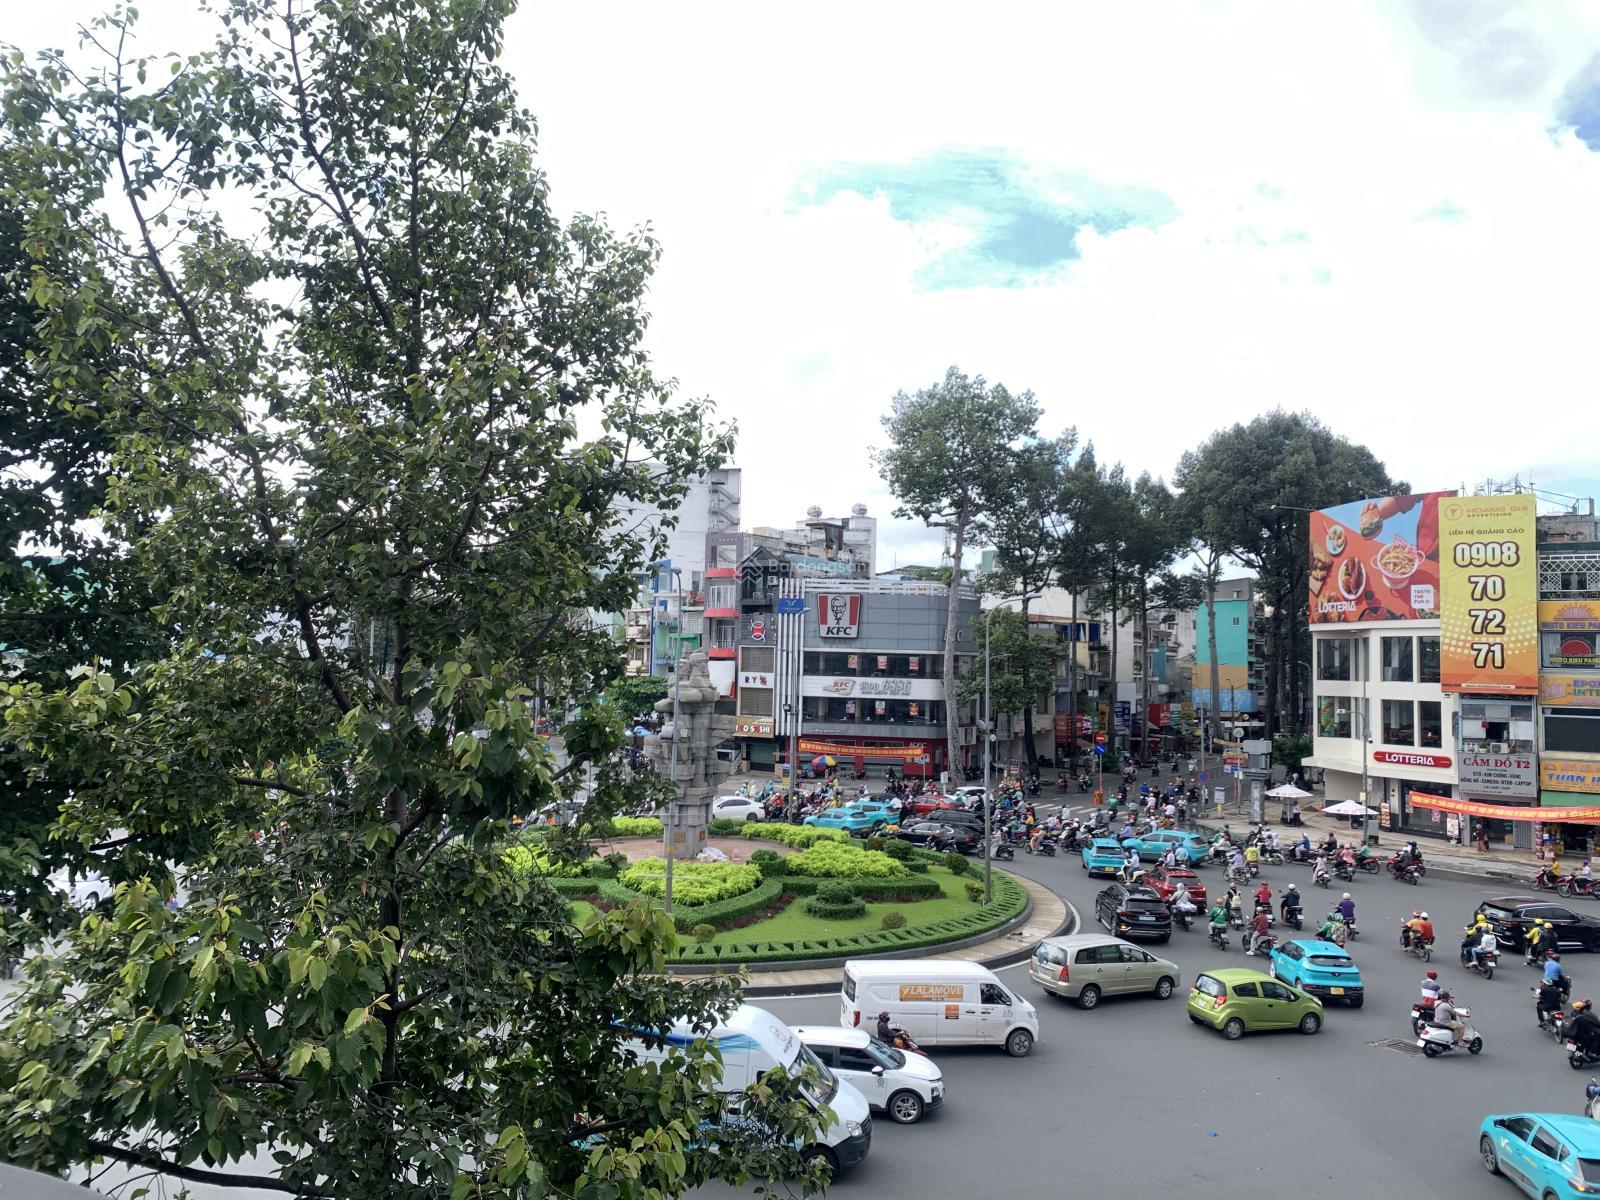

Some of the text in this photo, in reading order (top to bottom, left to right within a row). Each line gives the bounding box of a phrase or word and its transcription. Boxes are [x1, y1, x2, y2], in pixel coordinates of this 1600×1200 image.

[1454, 541, 1520, 568] 0908
[1469, 575, 1506, 602] 70
[1318, 601, 1357, 614] LOTTERIA
[1469, 608, 1506, 636] 72
[826, 626, 852, 636] KFC
[1471, 642, 1505, 669] 71
[1385, 752, 1435, 766] LOTTERIA
[1515, 759, 1531, 769] T2
[911, 985, 963, 995] LALAMOVE
